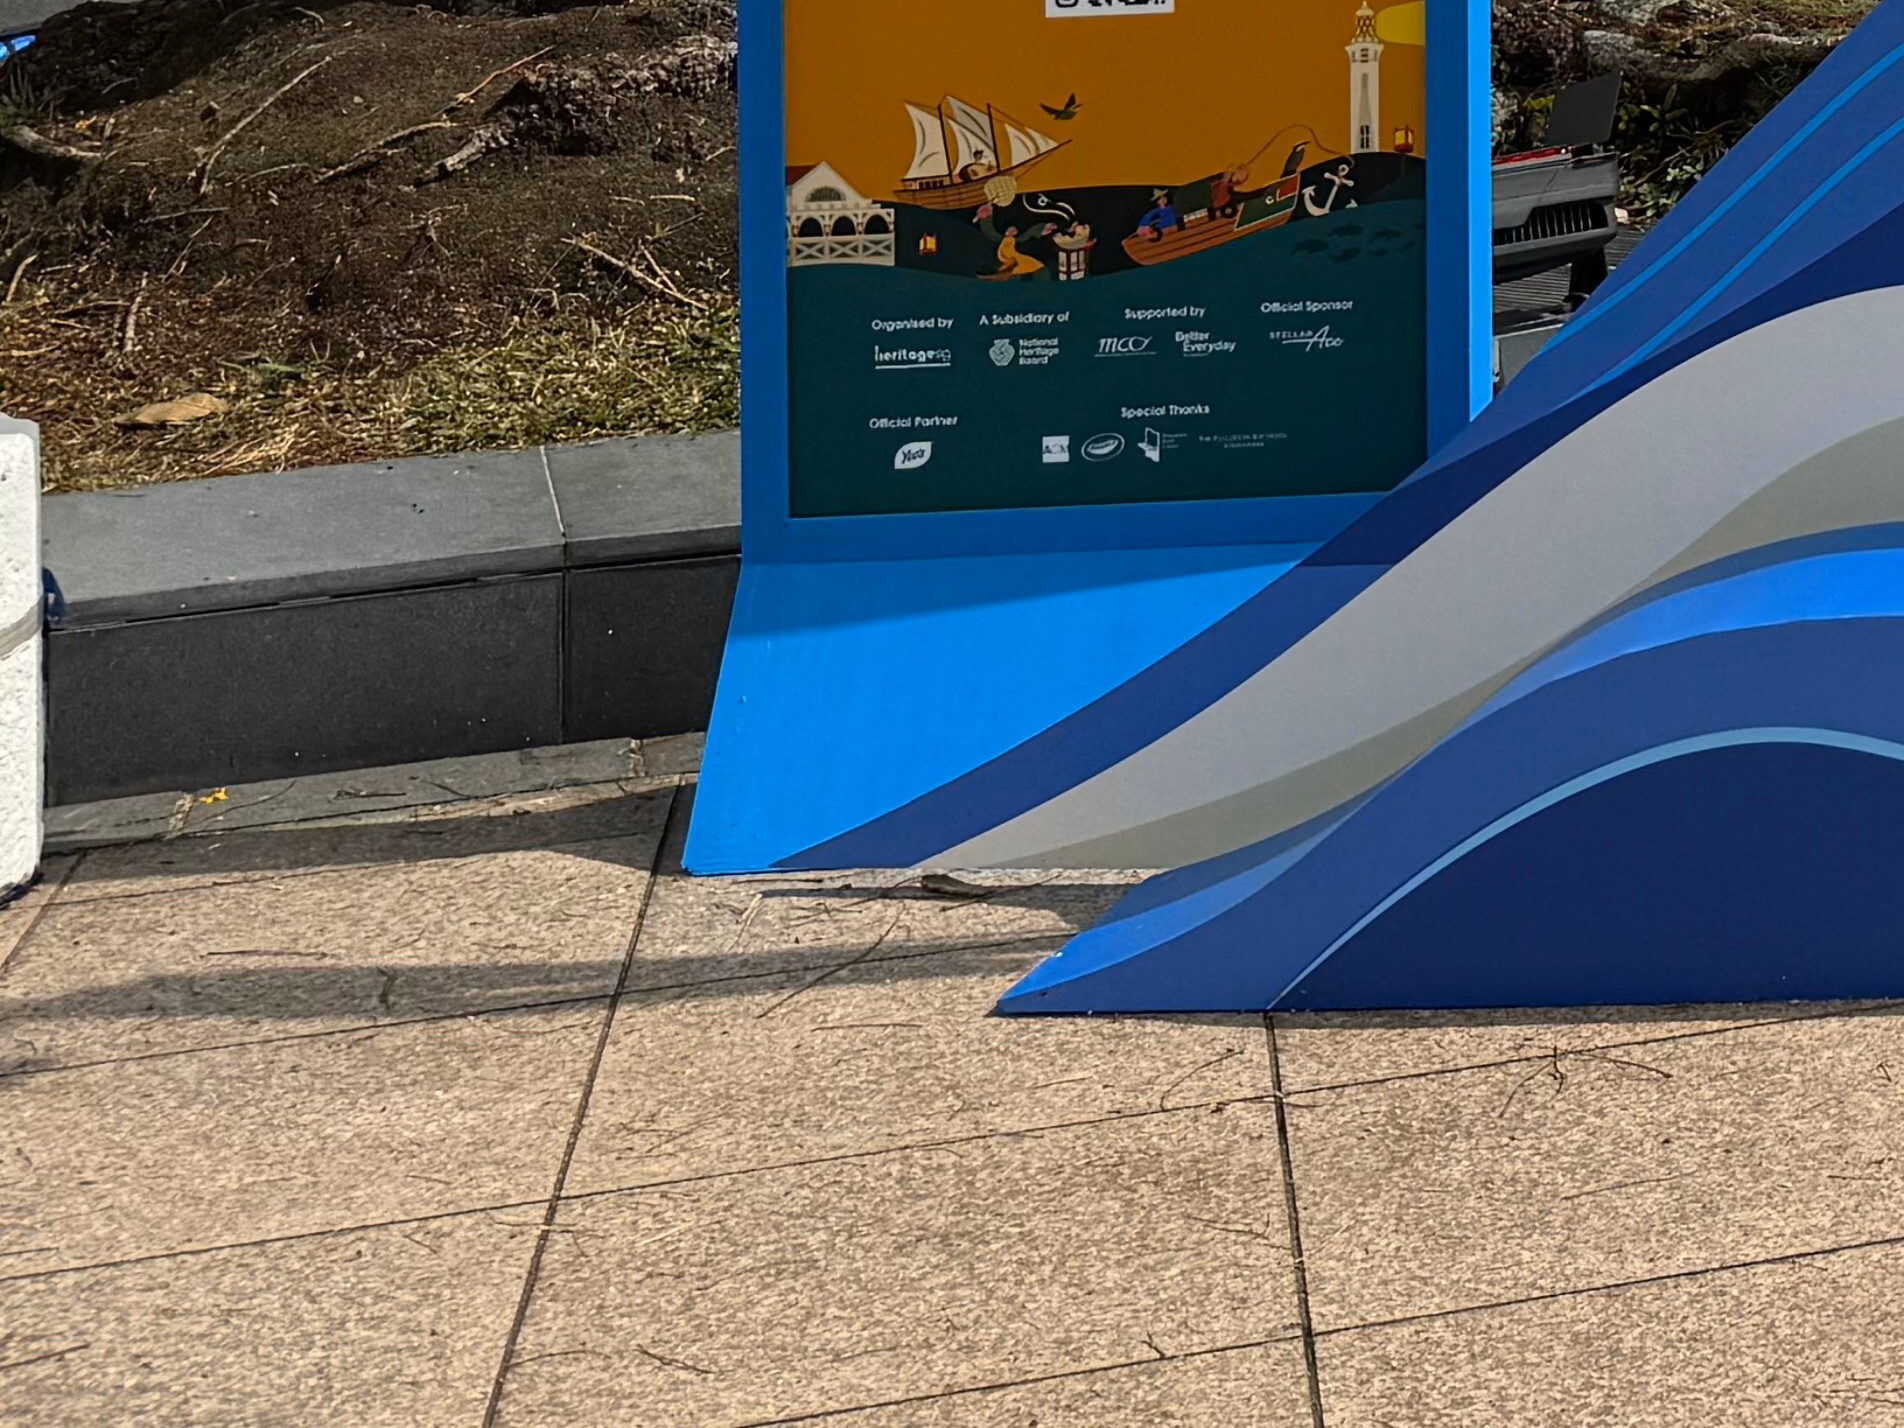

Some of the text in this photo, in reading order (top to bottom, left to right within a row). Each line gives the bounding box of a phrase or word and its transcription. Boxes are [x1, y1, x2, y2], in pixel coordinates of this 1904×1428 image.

[1124, 306, 1188, 321] Supported
[1120, 404, 1210, 419] Special Thanks
